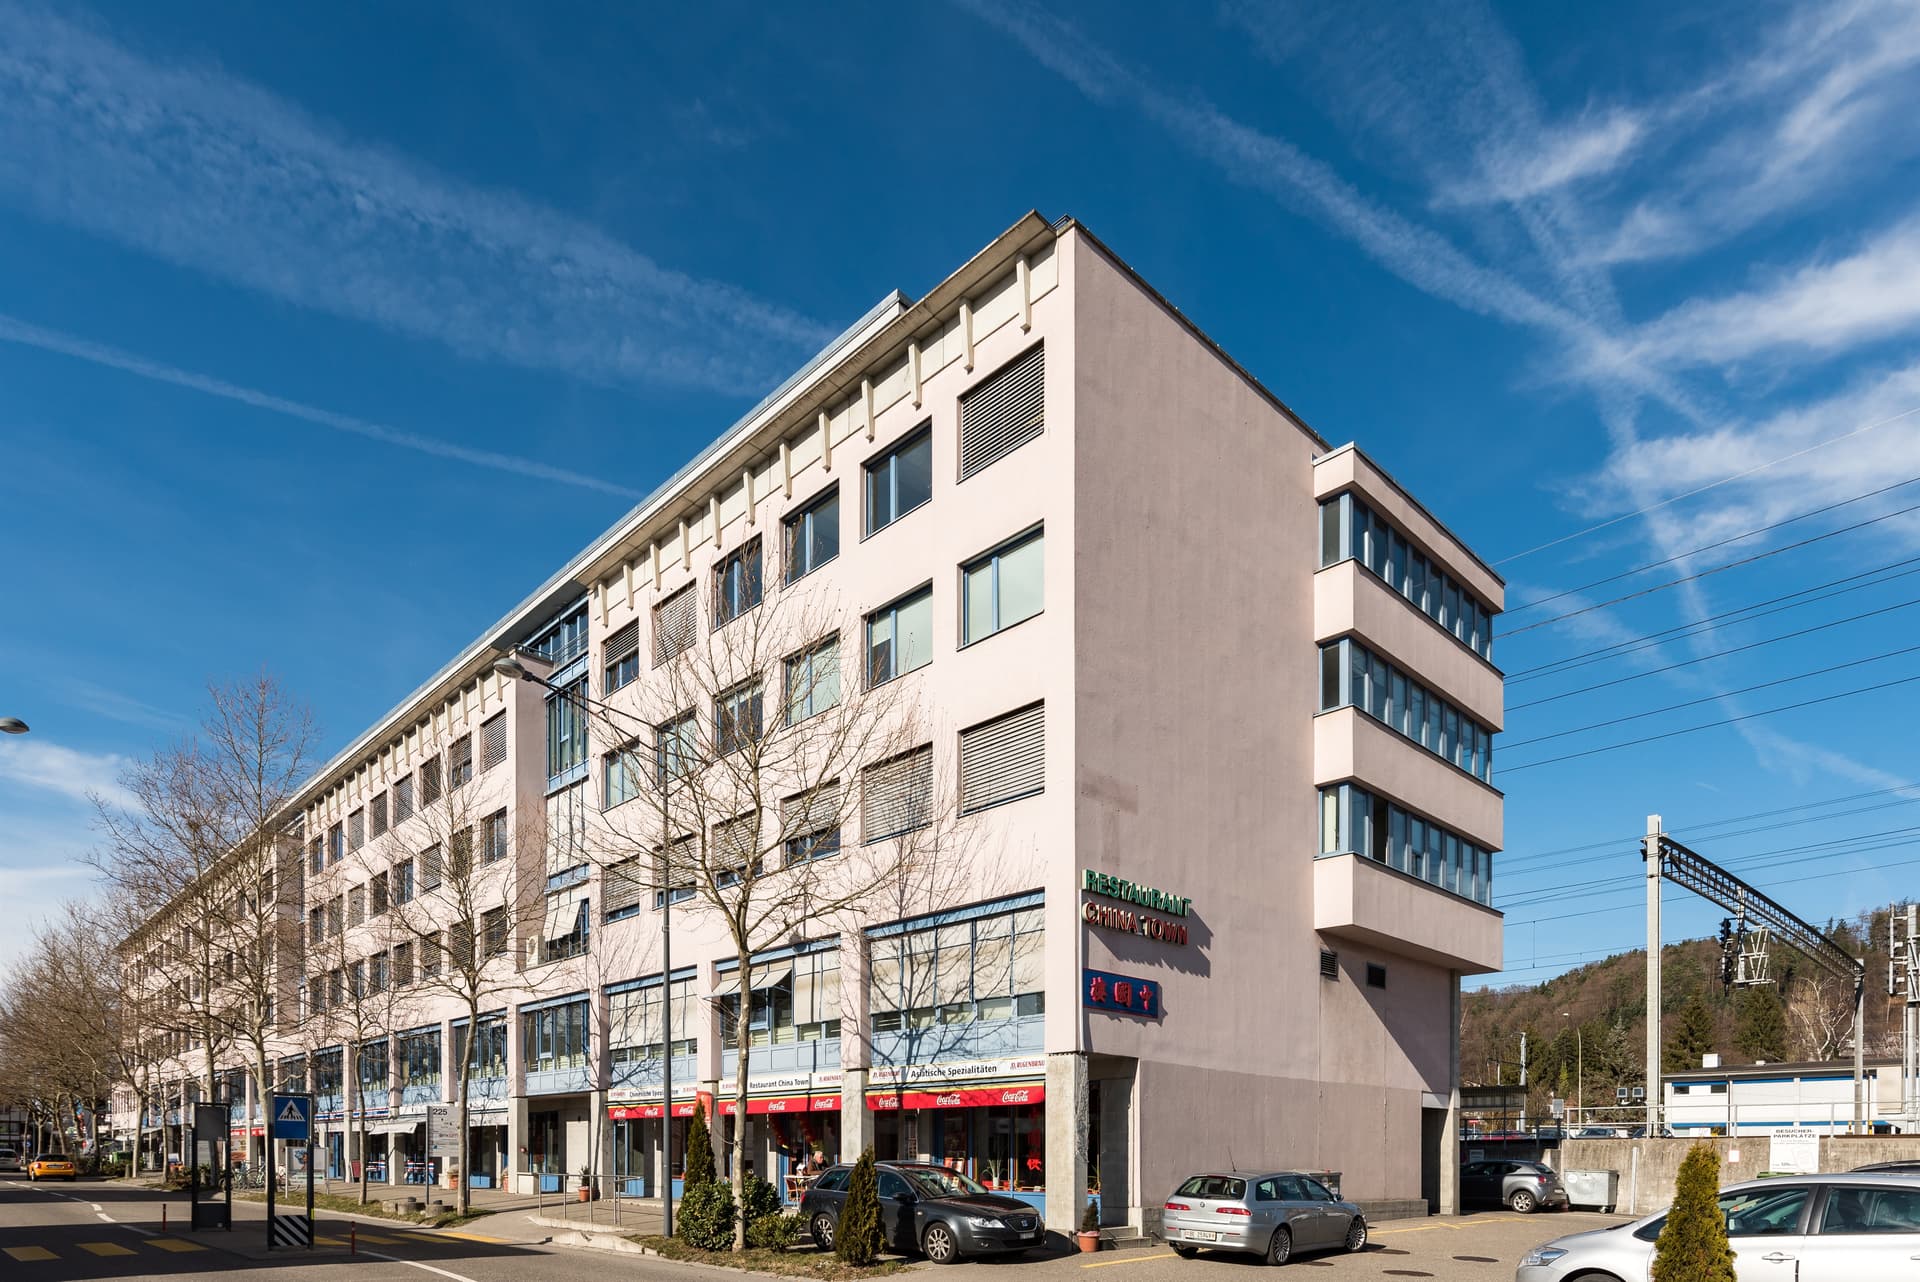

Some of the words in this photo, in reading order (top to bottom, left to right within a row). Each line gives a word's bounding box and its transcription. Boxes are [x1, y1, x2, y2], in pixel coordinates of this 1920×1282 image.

[1083, 869, 1192, 917] RESTAURANT
[1083, 902, 1138, 933] CHINA
[1140, 915, 1188, 945] TOWN
[911, 1067, 946, 1078] Asiatische
[948, 1065, 997, 1077] Spezialitäten
[750, 1079, 777, 1088] Restaurant
[778, 1079, 793, 1087] China
[794, 1078, 809, 1086] Town
[937, 1093, 960, 1105] Coca-Cola
[1002, 1090, 1029, 1103] Coca-Cola
